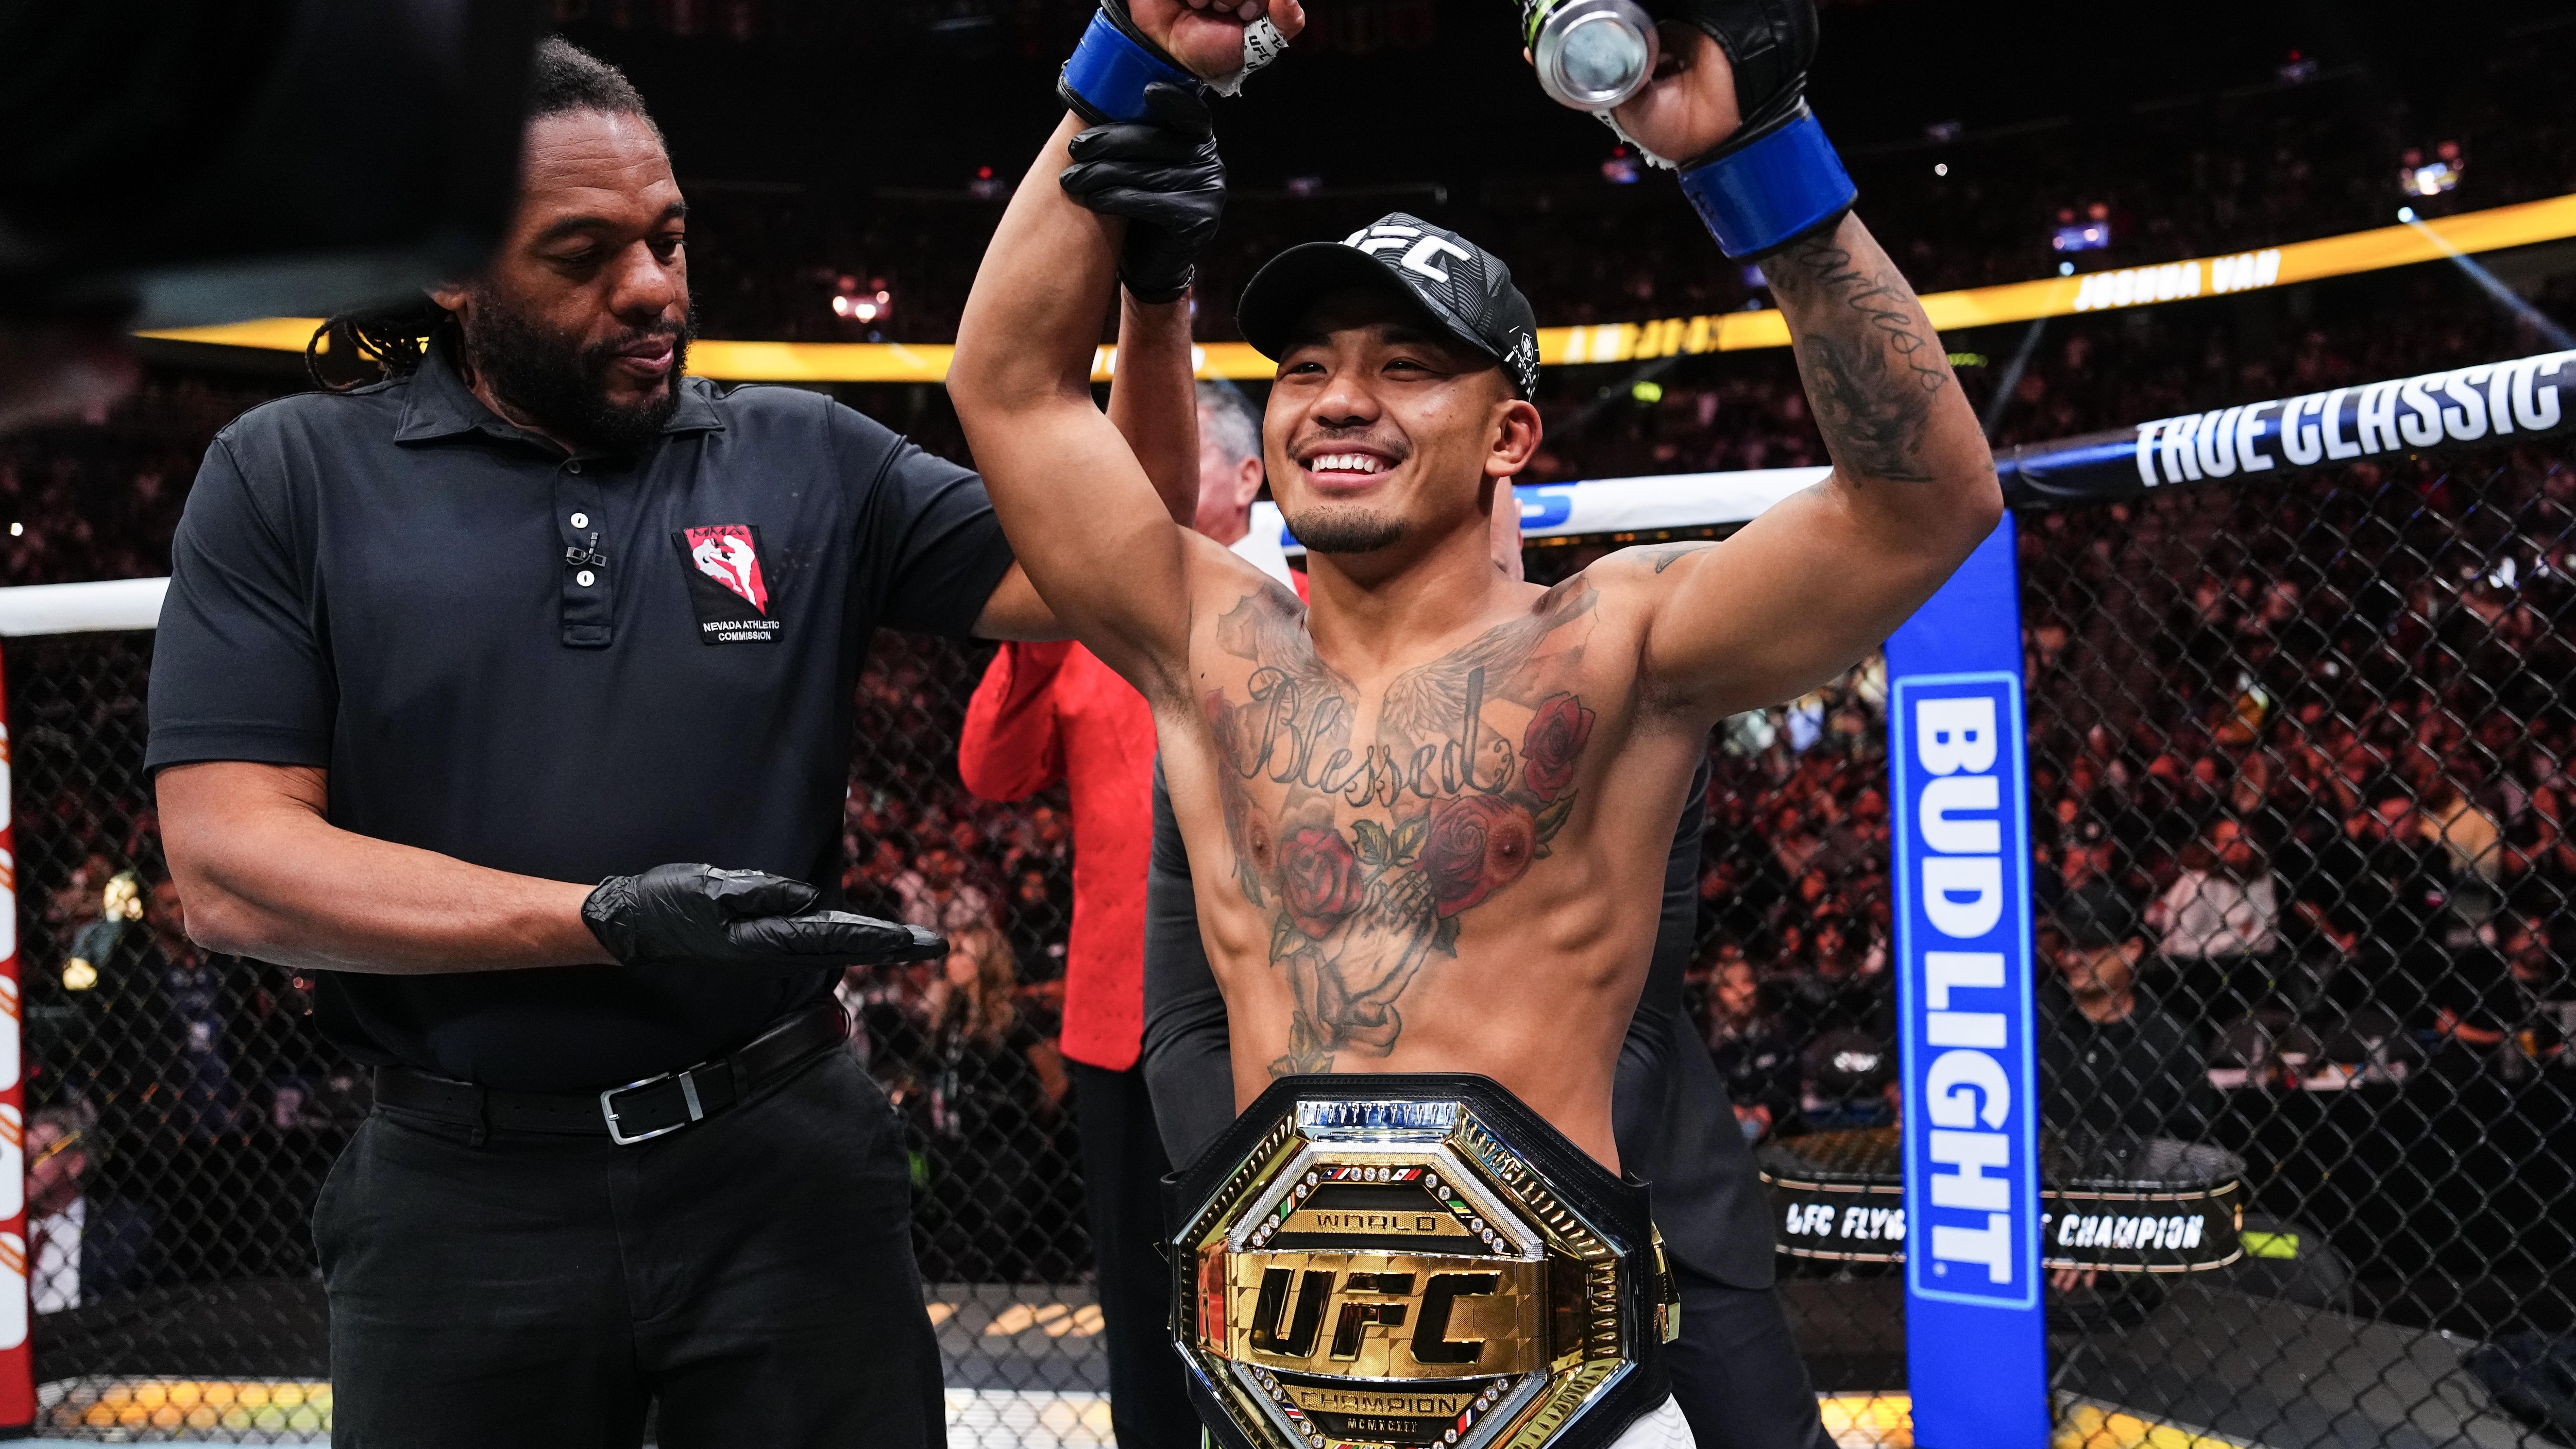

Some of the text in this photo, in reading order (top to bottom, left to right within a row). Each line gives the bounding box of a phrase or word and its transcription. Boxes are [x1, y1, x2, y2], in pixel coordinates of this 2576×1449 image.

[2073, 248, 2282, 312] JOSHUA VAN
[2136, 355, 2565, 487] TRUE CLASSIC
[693, 526, 744, 538] MMA
[703, 620, 780, 632] NEVADA ATHLETIC
[718, 631, 771, 642] COMMISSION
[1238, 665, 1516, 808] Blessed
[1916, 696, 2012, 1285] BUD LIGHT
[1317, 1214, 1435, 1231] WORLD
[2058, 1214, 2205, 1250] CHAMPION
[1249, 1268, 1502, 1364] UFC
[1301, 1392, 1457, 1413] CHAMPION
[1348, 1418, 1417, 1433] MCMXCIII
